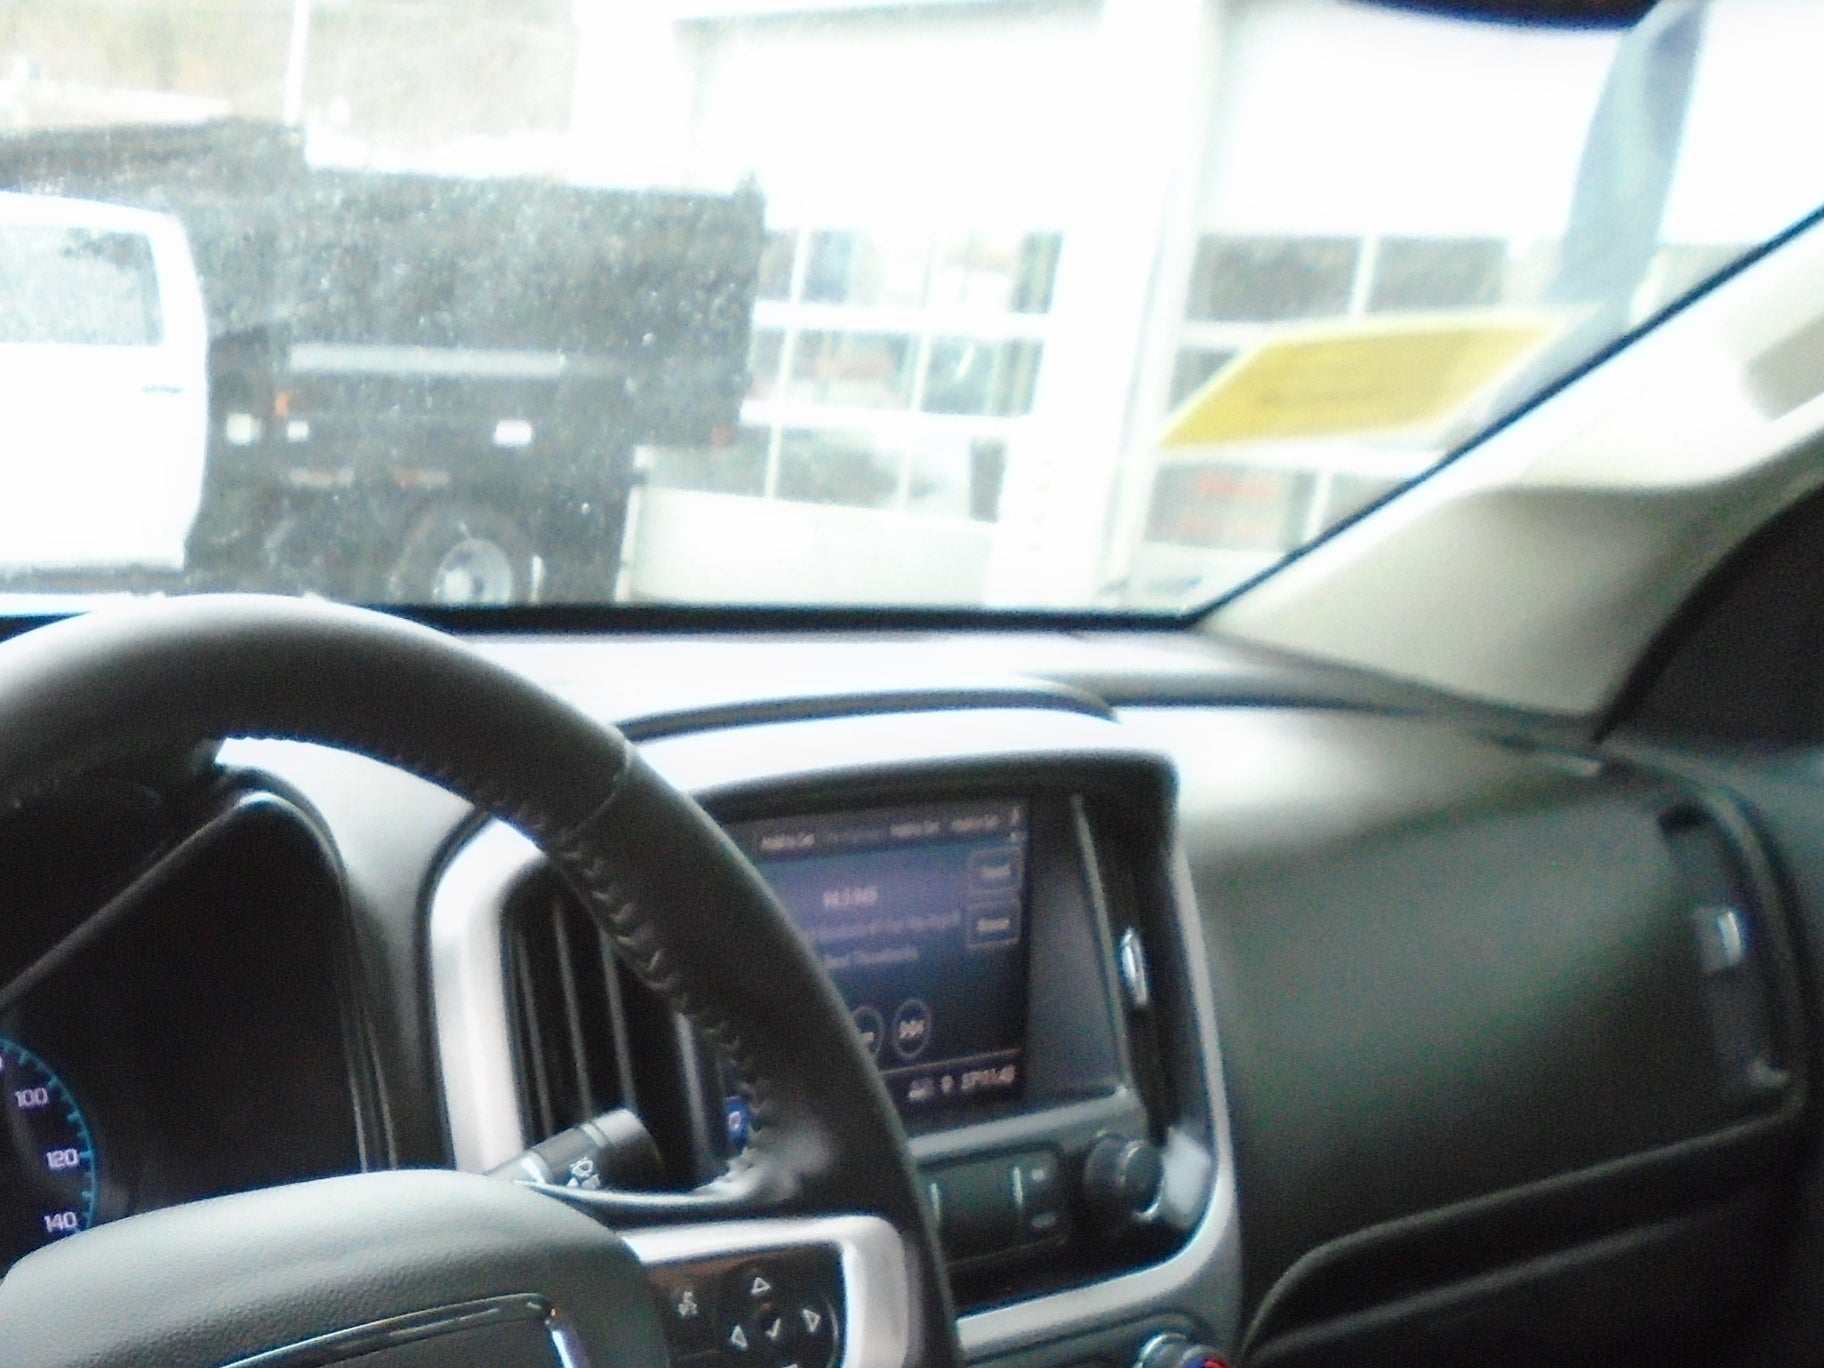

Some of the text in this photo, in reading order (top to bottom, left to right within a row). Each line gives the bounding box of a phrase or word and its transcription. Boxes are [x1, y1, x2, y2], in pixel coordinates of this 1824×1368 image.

[14, 1087, 49, 1108] 100
[46, 1148, 79, 1169] 120
[44, 1211, 77, 1233] 140
